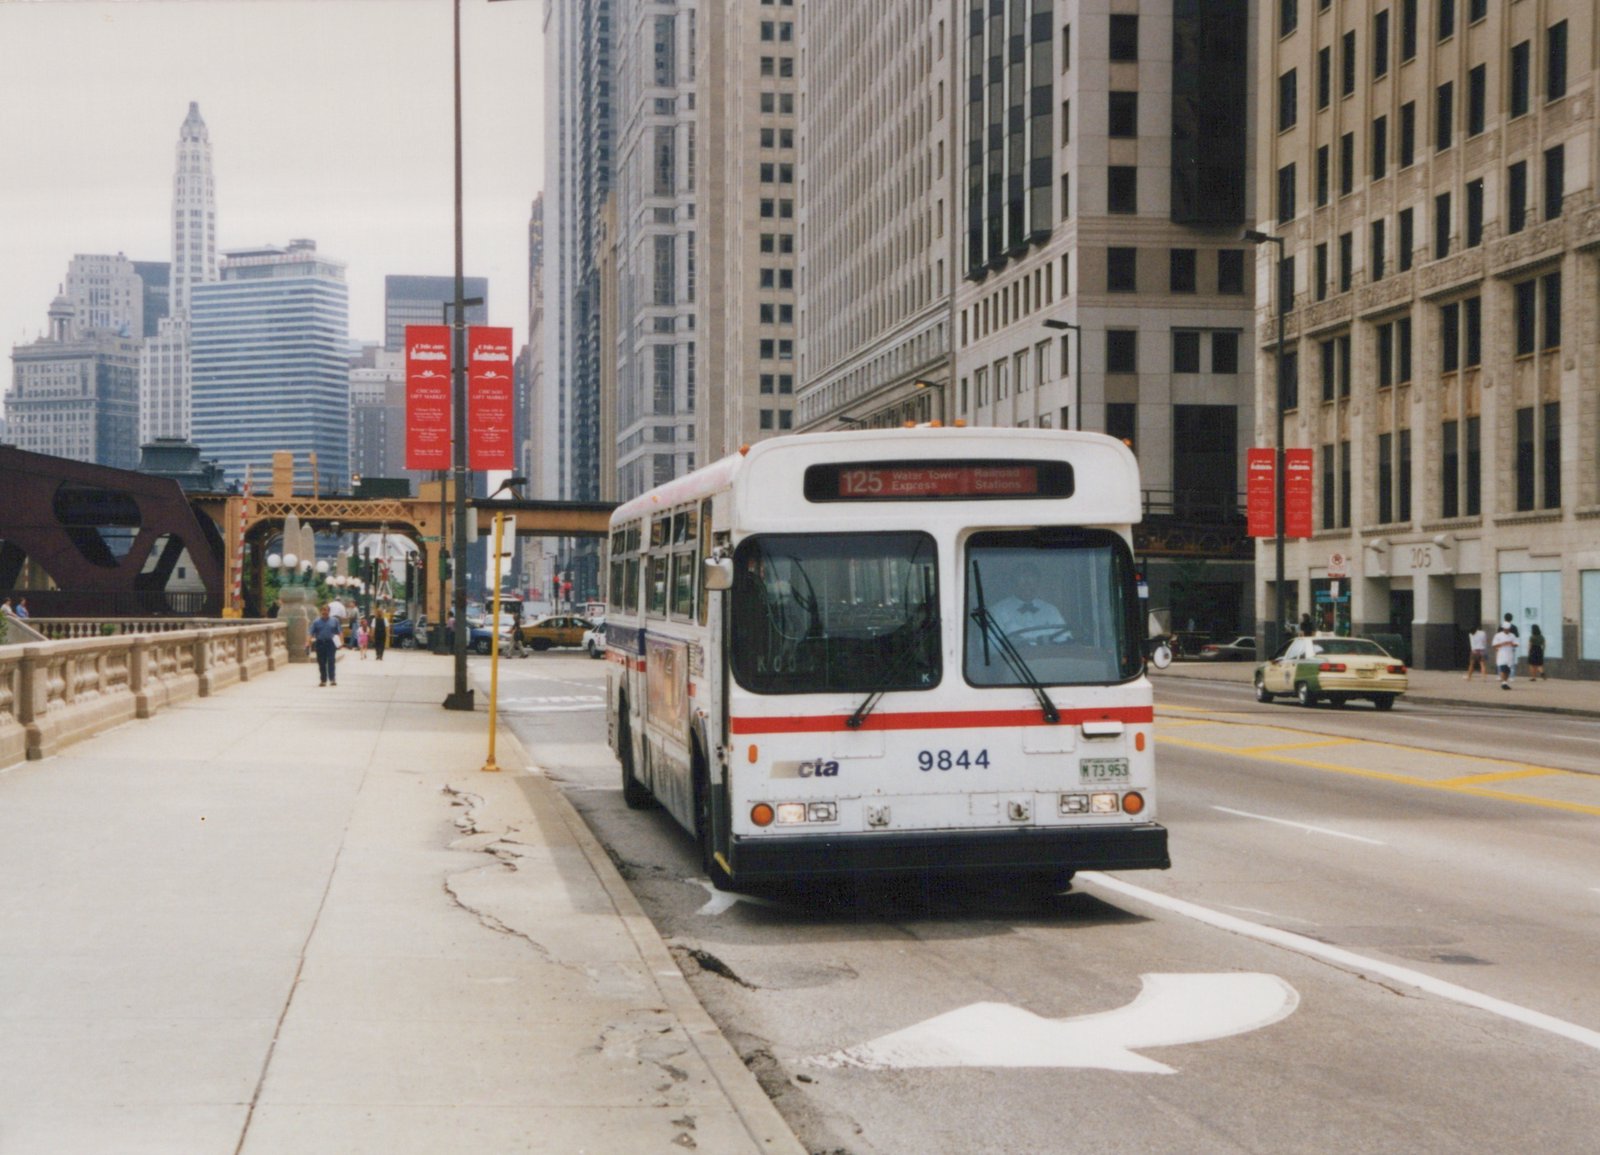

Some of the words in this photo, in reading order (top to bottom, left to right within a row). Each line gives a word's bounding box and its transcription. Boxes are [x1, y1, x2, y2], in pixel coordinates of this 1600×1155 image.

[892, 470, 923, 480] Water
[927, 470, 959, 480] Tower
[974, 468, 1021, 478] Railroad
[842, 470, 883, 493] 125
[892, 480, 938, 492] Express
[974, 479, 1022, 490] Stations
[917, 749, 991, 772] 9844
[797, 757, 840, 778] cta
[1091, 764, 1106, 777] 73
[1107, 763, 1129, 777] 953
